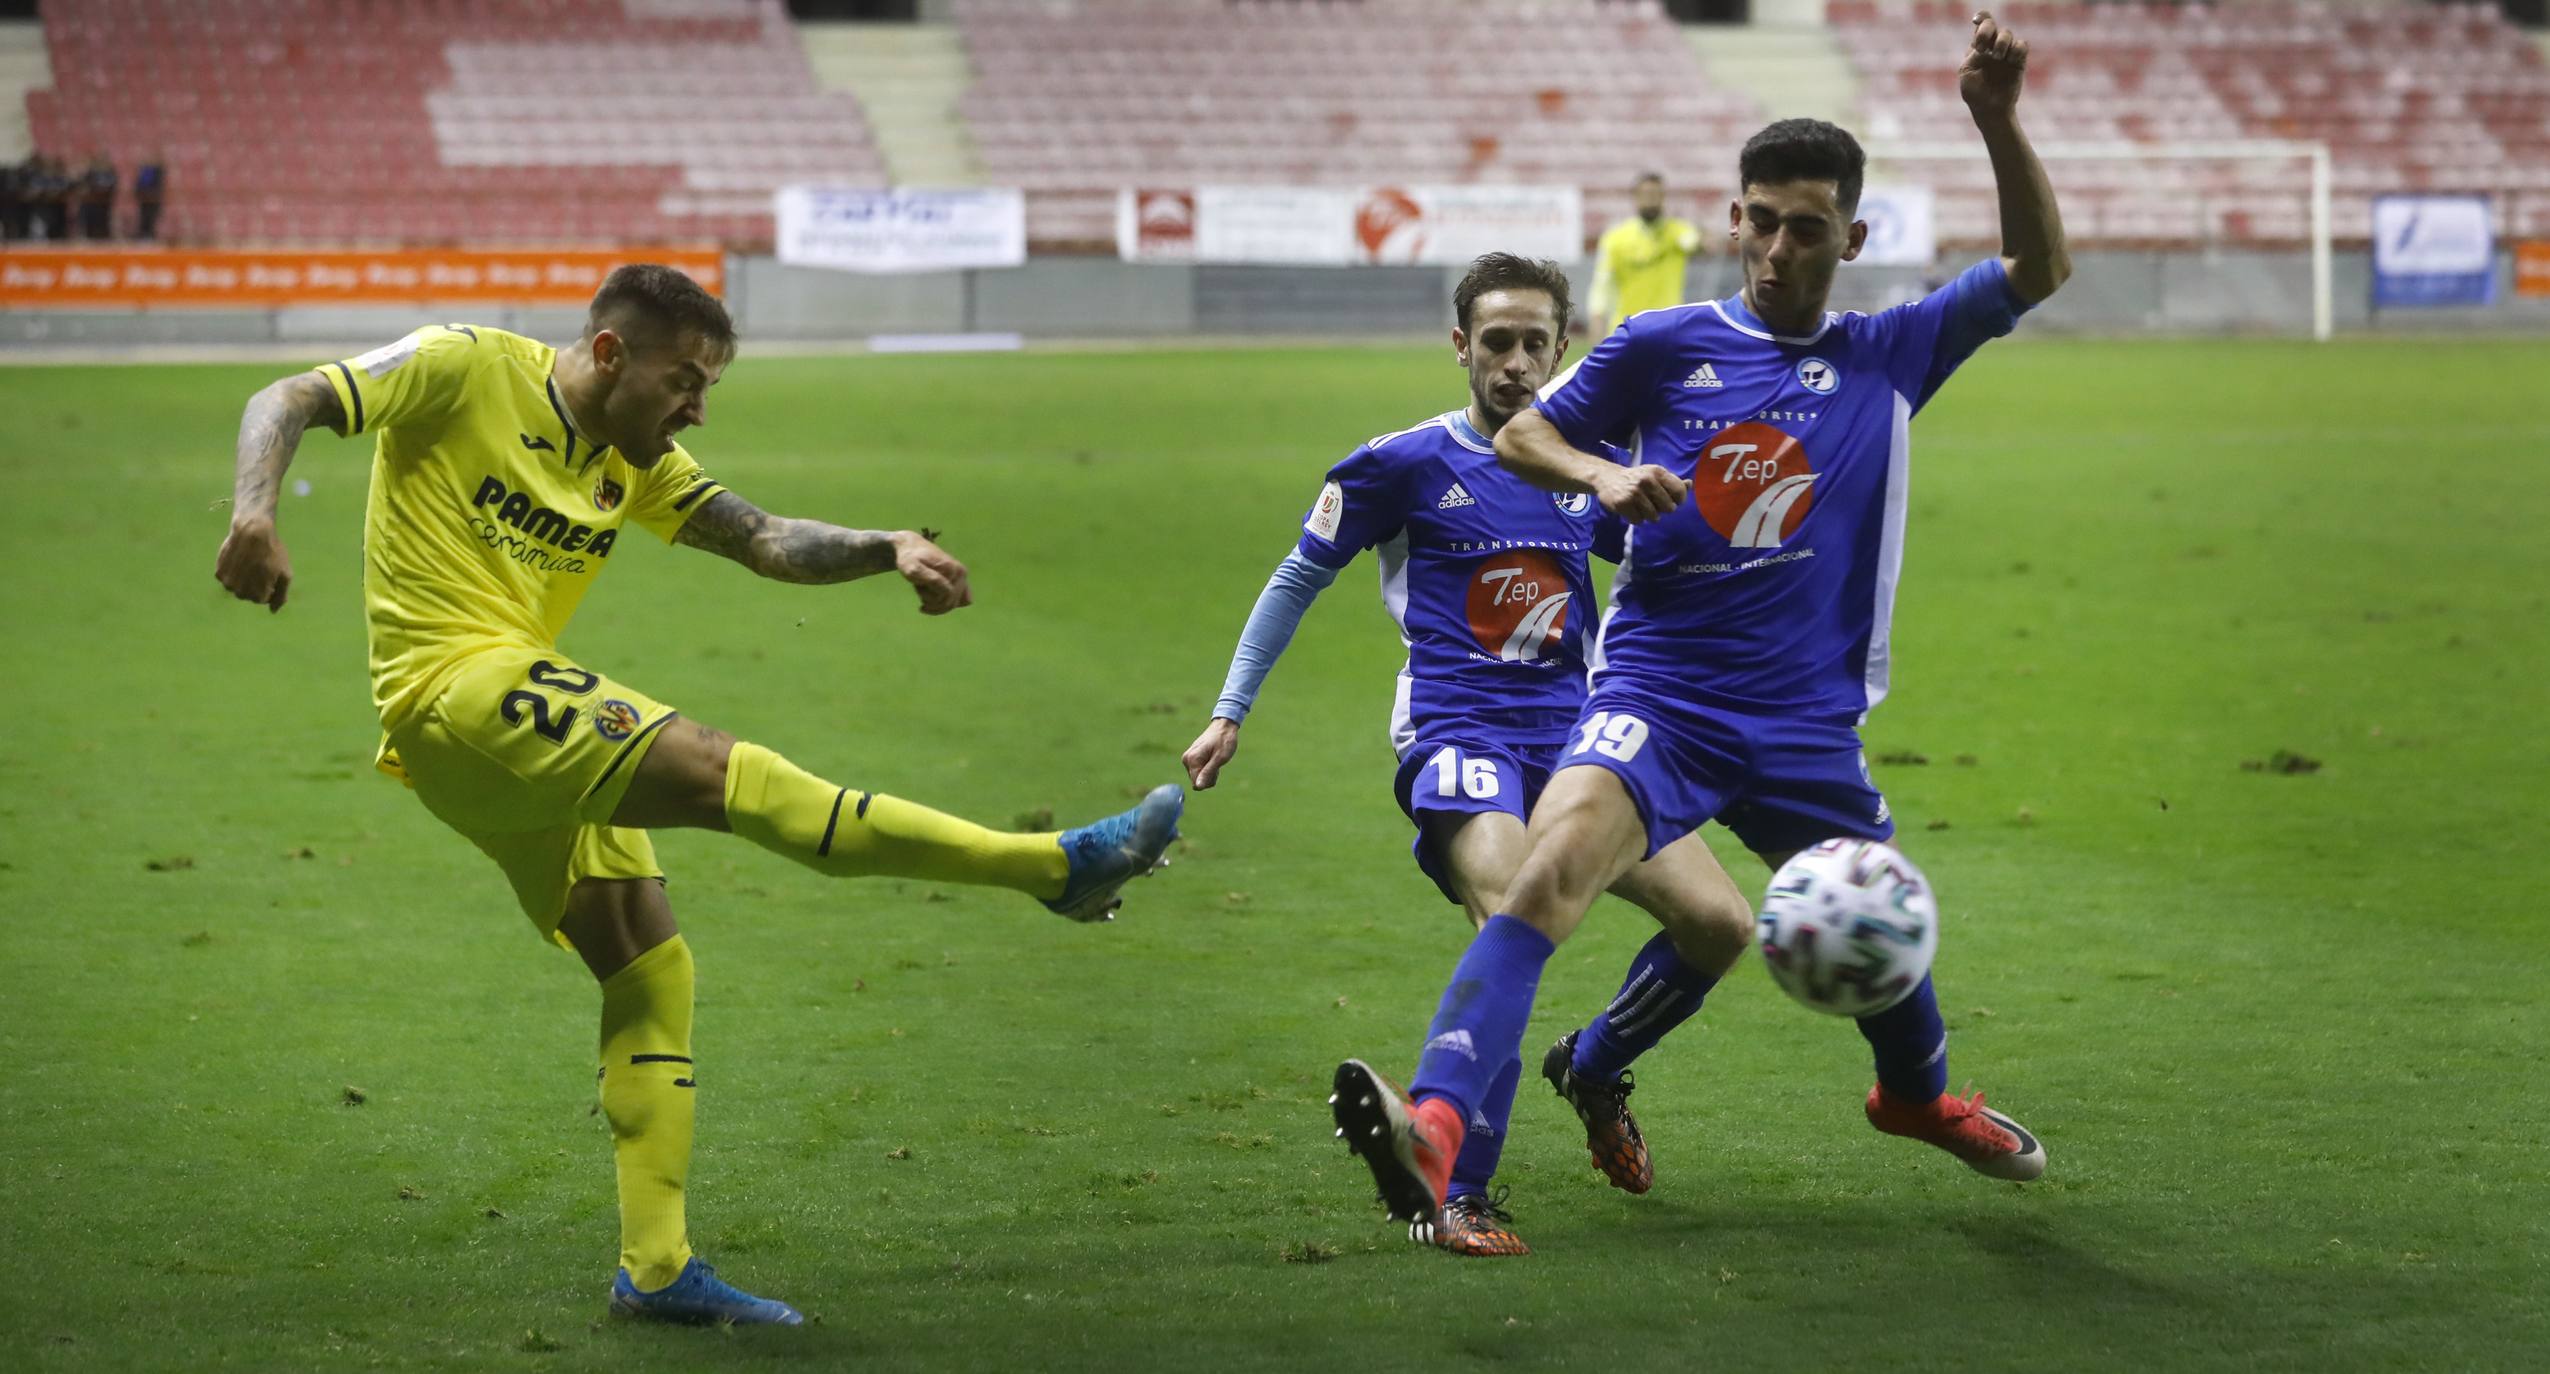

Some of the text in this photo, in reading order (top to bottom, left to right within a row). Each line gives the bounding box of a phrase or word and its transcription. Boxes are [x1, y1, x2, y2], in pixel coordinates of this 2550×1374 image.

[1683, 378, 1723, 388] adidas
[1684, 410, 1817, 430] TRANORTE
[1710, 443, 1778, 485] T.ep
[472, 474, 617, 558] PAMEA
[1438, 496, 1475, 510] adidas
[470, 517, 585, 574] cerámica
[1450, 540, 1579, 551] TRANSPORTES
[1481, 567, 1539, 606] T.ep
[1680, 563, 1733, 574] NACIONAL
[501, 660, 599, 747] 20
[1572, 711, 1649, 763] 19
[1429, 747, 1499, 798] 16
